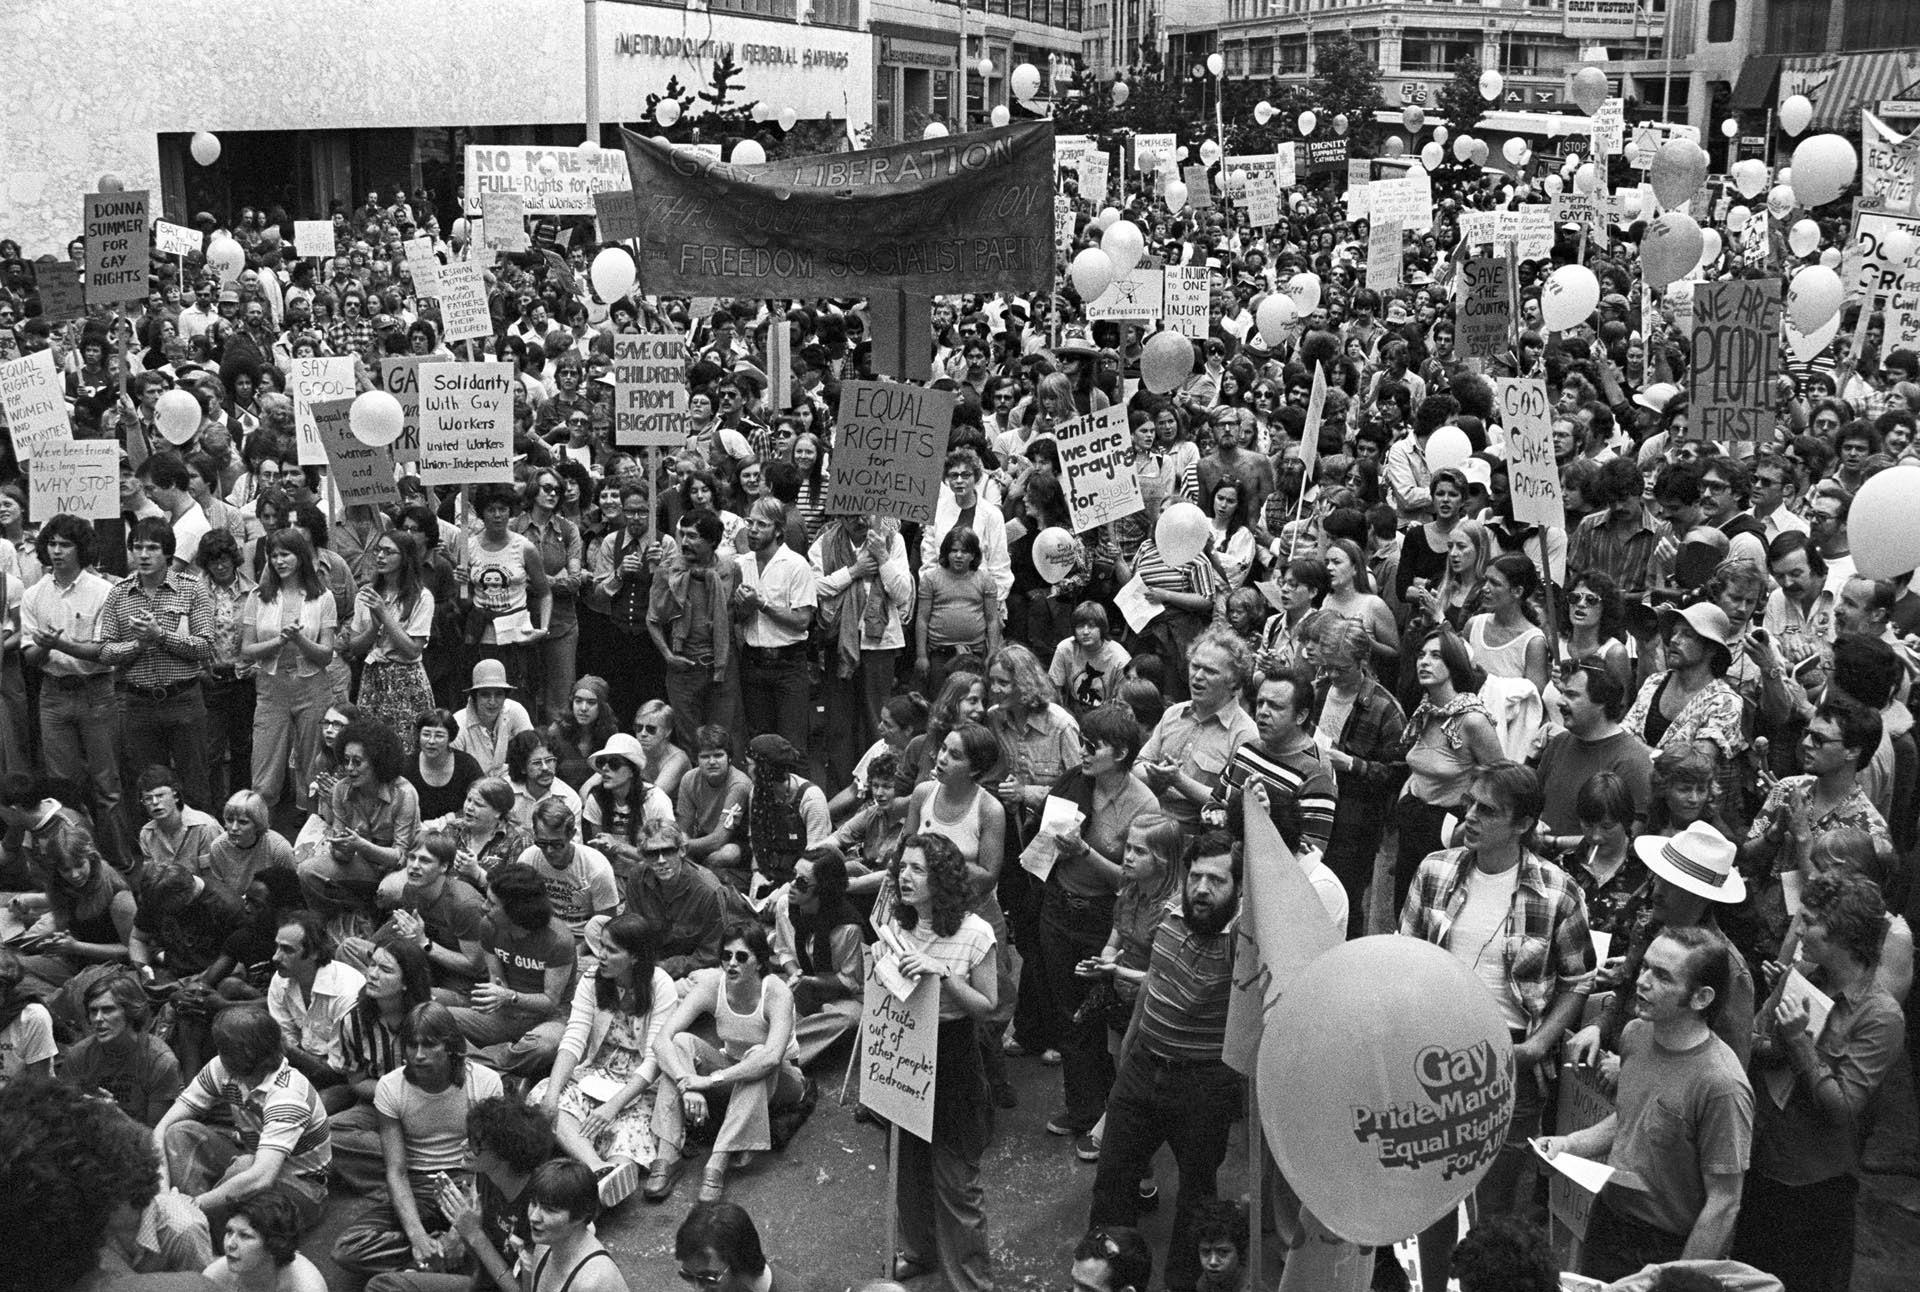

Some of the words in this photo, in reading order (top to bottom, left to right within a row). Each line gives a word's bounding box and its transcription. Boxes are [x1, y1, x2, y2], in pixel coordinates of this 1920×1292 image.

[1568, 1, 1594, 12] GREAT
[1596, 2, 1634, 14] WESTERN
[615, 32, 735, 61] METROPOLITAN
[742, 43, 798, 66] FEDERAL
[1310, 139, 1348, 151] DIGNITY
[1564, 141, 1587, 152] STOP
[476, 150, 510, 172] NO
[526, 150, 581, 174] MRE
[792, 136, 1013, 187] LIBERATION
[95, 201, 145, 218] DONNA
[1559, 195, 1588, 204] EMPTY
[1560, 210, 1582, 220] GAY
[88, 218, 143, 238] SUMMER
[159, 222, 179, 236] SAY
[102, 238, 128, 252] FOR
[101, 254, 127, 269] GAY
[679, 243, 814, 278] FREEDOM
[827, 239, 966, 278] SOCIALIST
[974, 237, 1044, 271] PARTY
[94, 270, 141, 286] RIGHTS
[1180, 266, 1211, 280] INJURY
[1463, 260, 1503, 287] SAVE
[442, 290, 476, 302] FAGGOT
[1182, 280, 1207, 292] ONE
[1475, 284, 1500, 298] THE
[447, 300, 486, 310] FATHERS
[1172, 294, 1180, 302] IS
[1464, 296, 1510, 317] COUNTRY
[1692, 283, 1732, 324] WE
[1734, 284, 1785, 332] ARE
[1892, 292, 1918, 312] Civil
[1166, 304, 1208, 317] INJURY
[616, 341, 651, 360] SAVE
[652, 341, 685, 361] OUR
[0, 358, 41, 380] EQUAL
[301, 360, 329, 378] SAY
[616, 366, 686, 385] CHILDREN
[1690, 324, 1780, 411] PEOPLE
[2, 372, 46, 394] RIGHTS
[388, 366, 419, 395] GA
[434, 374, 510, 395] Solidarity
[7, 395, 21, 408] FOR
[426, 396, 460, 412] With
[470, 394, 499, 412] Gay
[629, 390, 675, 410] FROM
[855, 388, 934, 429] EQUAL
[1504, 384, 1545, 421] GOD
[9, 400, 54, 422] WOMEN
[14, 422, 30, 434] AND
[438, 416, 496, 432] Workers
[617, 412, 687, 433] BIGOTRY
[1700, 407, 1764, 442] FIRST
[64, 444, 84, 457] been
[85, 444, 114, 457] friends
[466, 438, 505, 450] Workers
[844, 423, 934, 458] RIGHTS
[1060, 444, 1087, 463] we
[1088, 432, 1122, 454] are
[1510, 426, 1550, 467] SAVE
[336, 448, 378, 460] women
[867, 453, 894, 467] for
[32, 462, 56, 474] this
[352, 466, 373, 478] and
[420, 457, 510, 472] Union-Independent
[1066, 446, 1136, 490] praying
[34, 478, 71, 494] WHY
[78, 475, 116, 493] STOP
[342, 484, 396, 500] minorities
[838, 468, 926, 507] WOMEN
[864, 488, 888, 496] and
[1514, 472, 1556, 502] ANITA
[56, 496, 97, 513] NOW
[832, 494, 930, 522] MINORITIES
[1070, 488, 1098, 512] for
[872, 993, 916, 1031] Anita
[868, 1022, 888, 1040] out
[890, 1027, 904, 1052] of
[868, 1040, 894, 1062] other
[896, 1052, 934, 1077] people's
[1413, 1038, 1489, 1090] Gay
[868, 1061, 930, 1101] Bedrooms!
[1349, 1100, 1438, 1133] Pride
[1437, 1075, 1511, 1121] March
[1375, 1127, 1449, 1165] Equal
[1454, 1101, 1512, 1146] Rights
[1441, 1150, 1477, 1175] For
